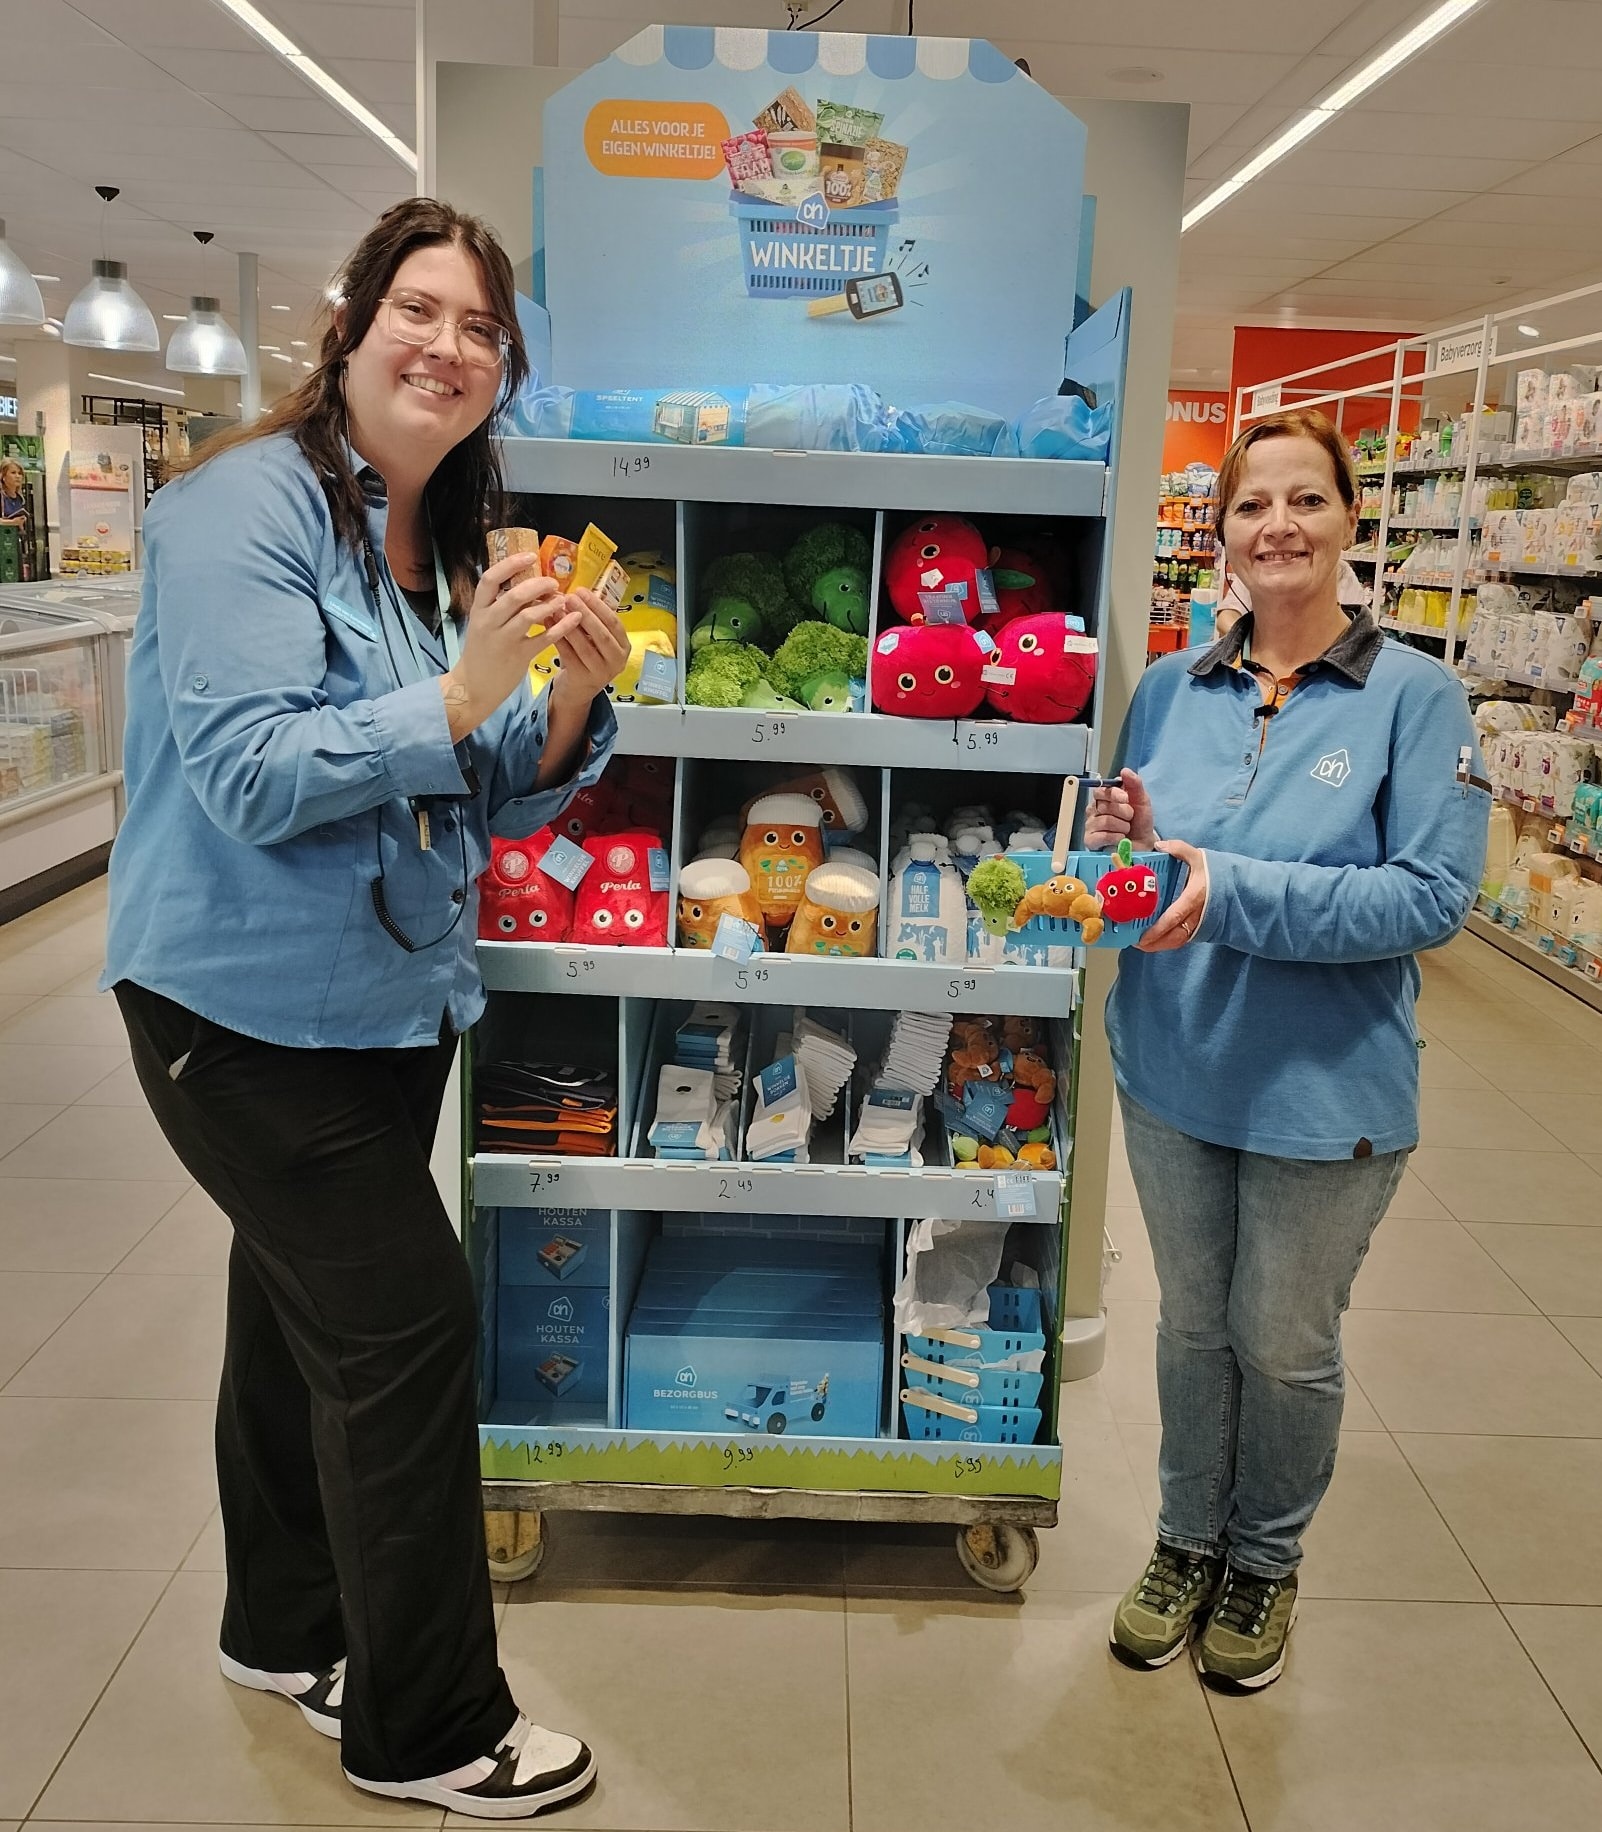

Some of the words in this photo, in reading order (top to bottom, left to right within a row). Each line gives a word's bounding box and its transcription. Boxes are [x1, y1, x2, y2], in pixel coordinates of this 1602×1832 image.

[610, 119, 650, 135] ALLES
[651, 121, 690, 137] VOOR
[691, 123, 705, 138] JE
[602, 140, 641, 156] EIGEN
[643, 142, 716, 160] WINKELTJE!
[750, 240, 876, 273] WINKELTJE
[1440, 337, 1494, 363] Babyverzorgg
[588, 541, 607, 560] Care
[499, 884, 541, 898] Perla
[600, 880, 642, 893] Perla
[911, 884, 929, 895] HALF
[908, 894, 930, 904] VOLLE
[909, 903, 929, 913] MELK
[971, 1187, 995, 1208] 2.4
[538, 1207, 587, 1217] HOUTEN
[543, 1217, 583, 1227] KASSA
[536, 1324, 585, 1335] HOUTEN
[541, 1334, 580, 1344] KASSA
[653, 1389, 718, 1400] BEZORGBUS
